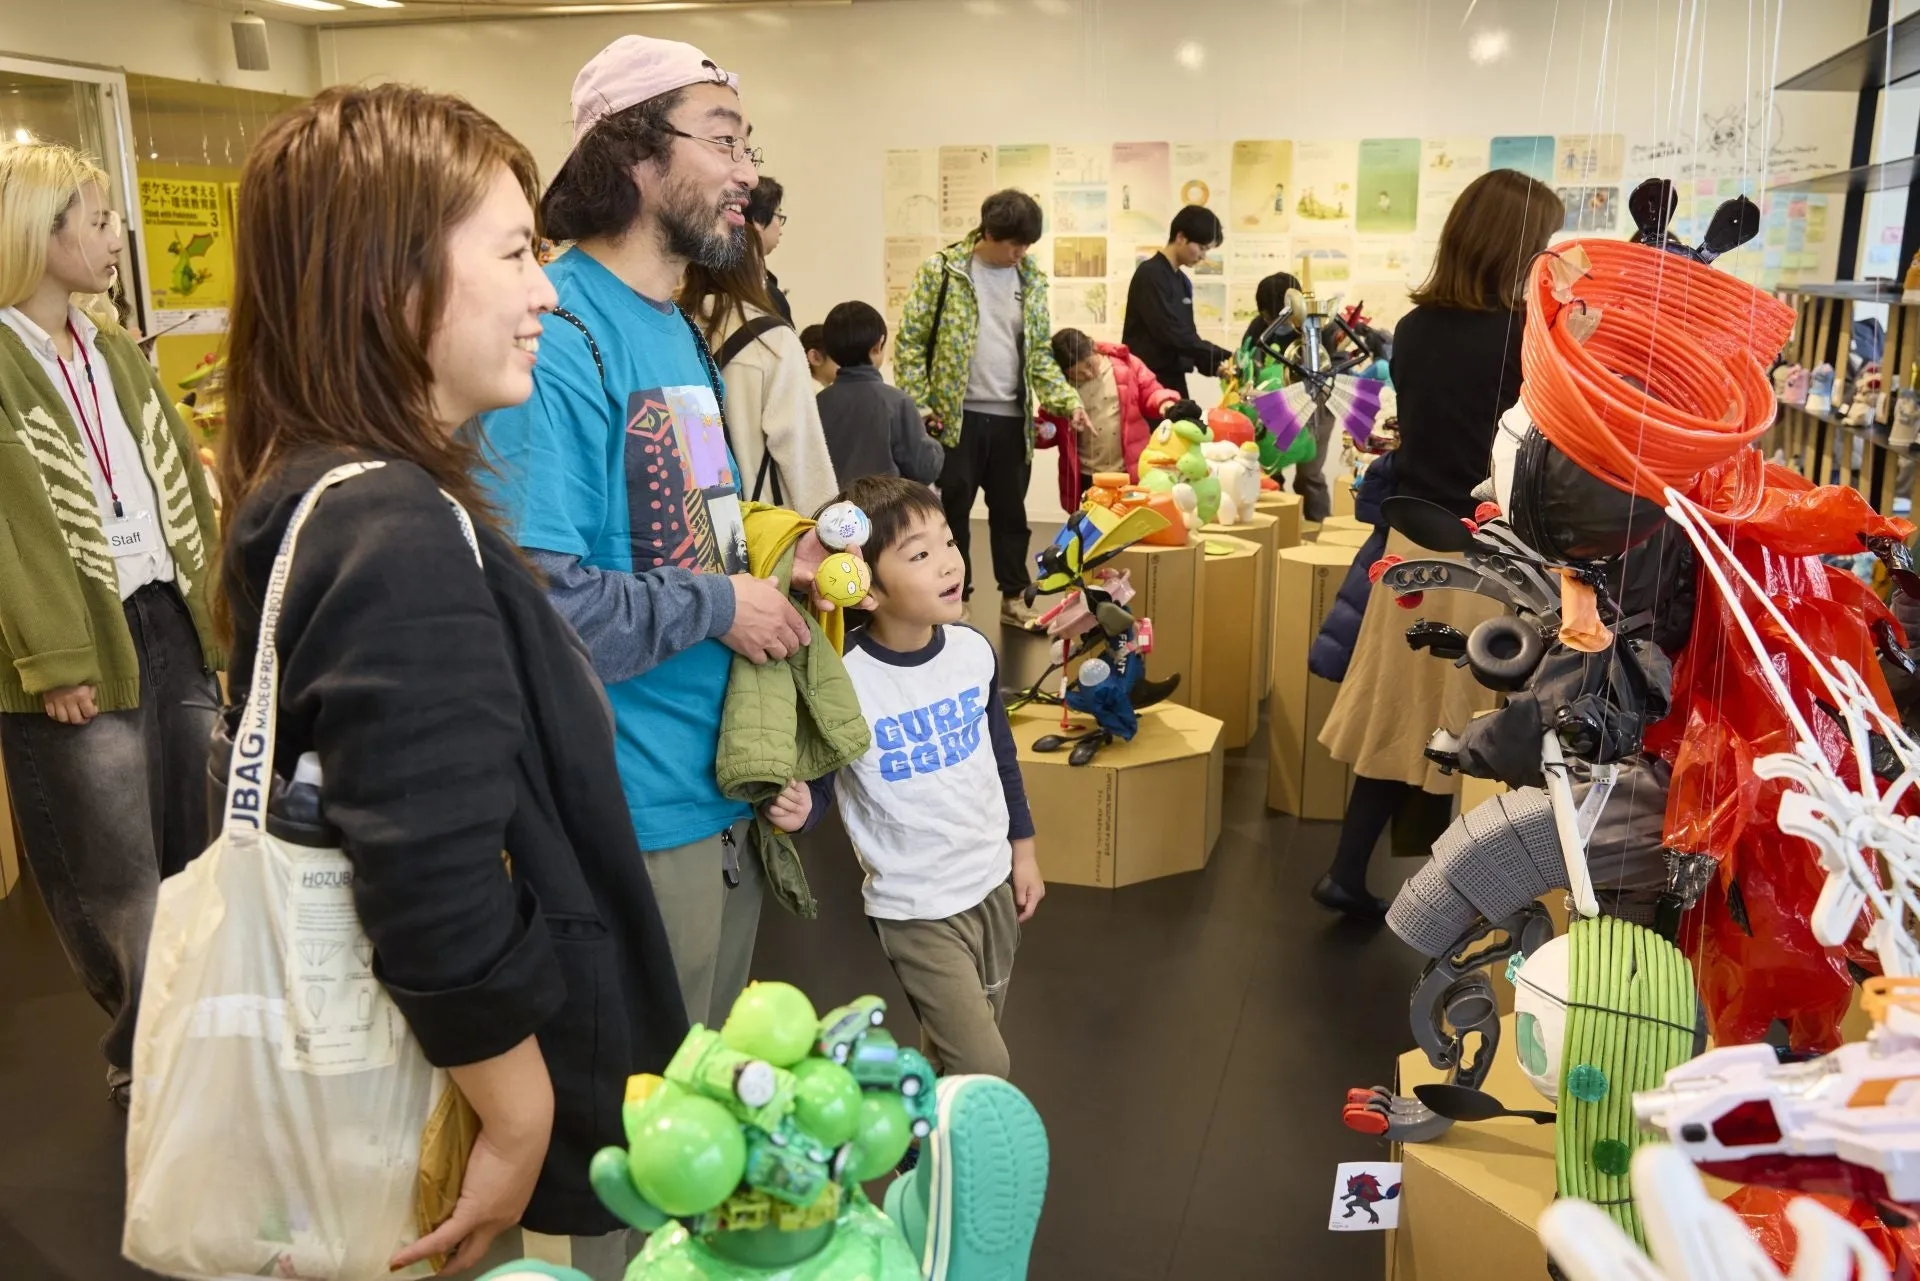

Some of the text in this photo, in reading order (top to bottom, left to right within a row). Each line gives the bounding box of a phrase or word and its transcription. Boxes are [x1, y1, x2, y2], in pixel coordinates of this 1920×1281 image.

[111, 531, 141, 546] Staff
[1117, 633, 1127, 674] FRNT
[256, 690, 269, 729] MADE
[302, 871, 354, 886] HOZUB
